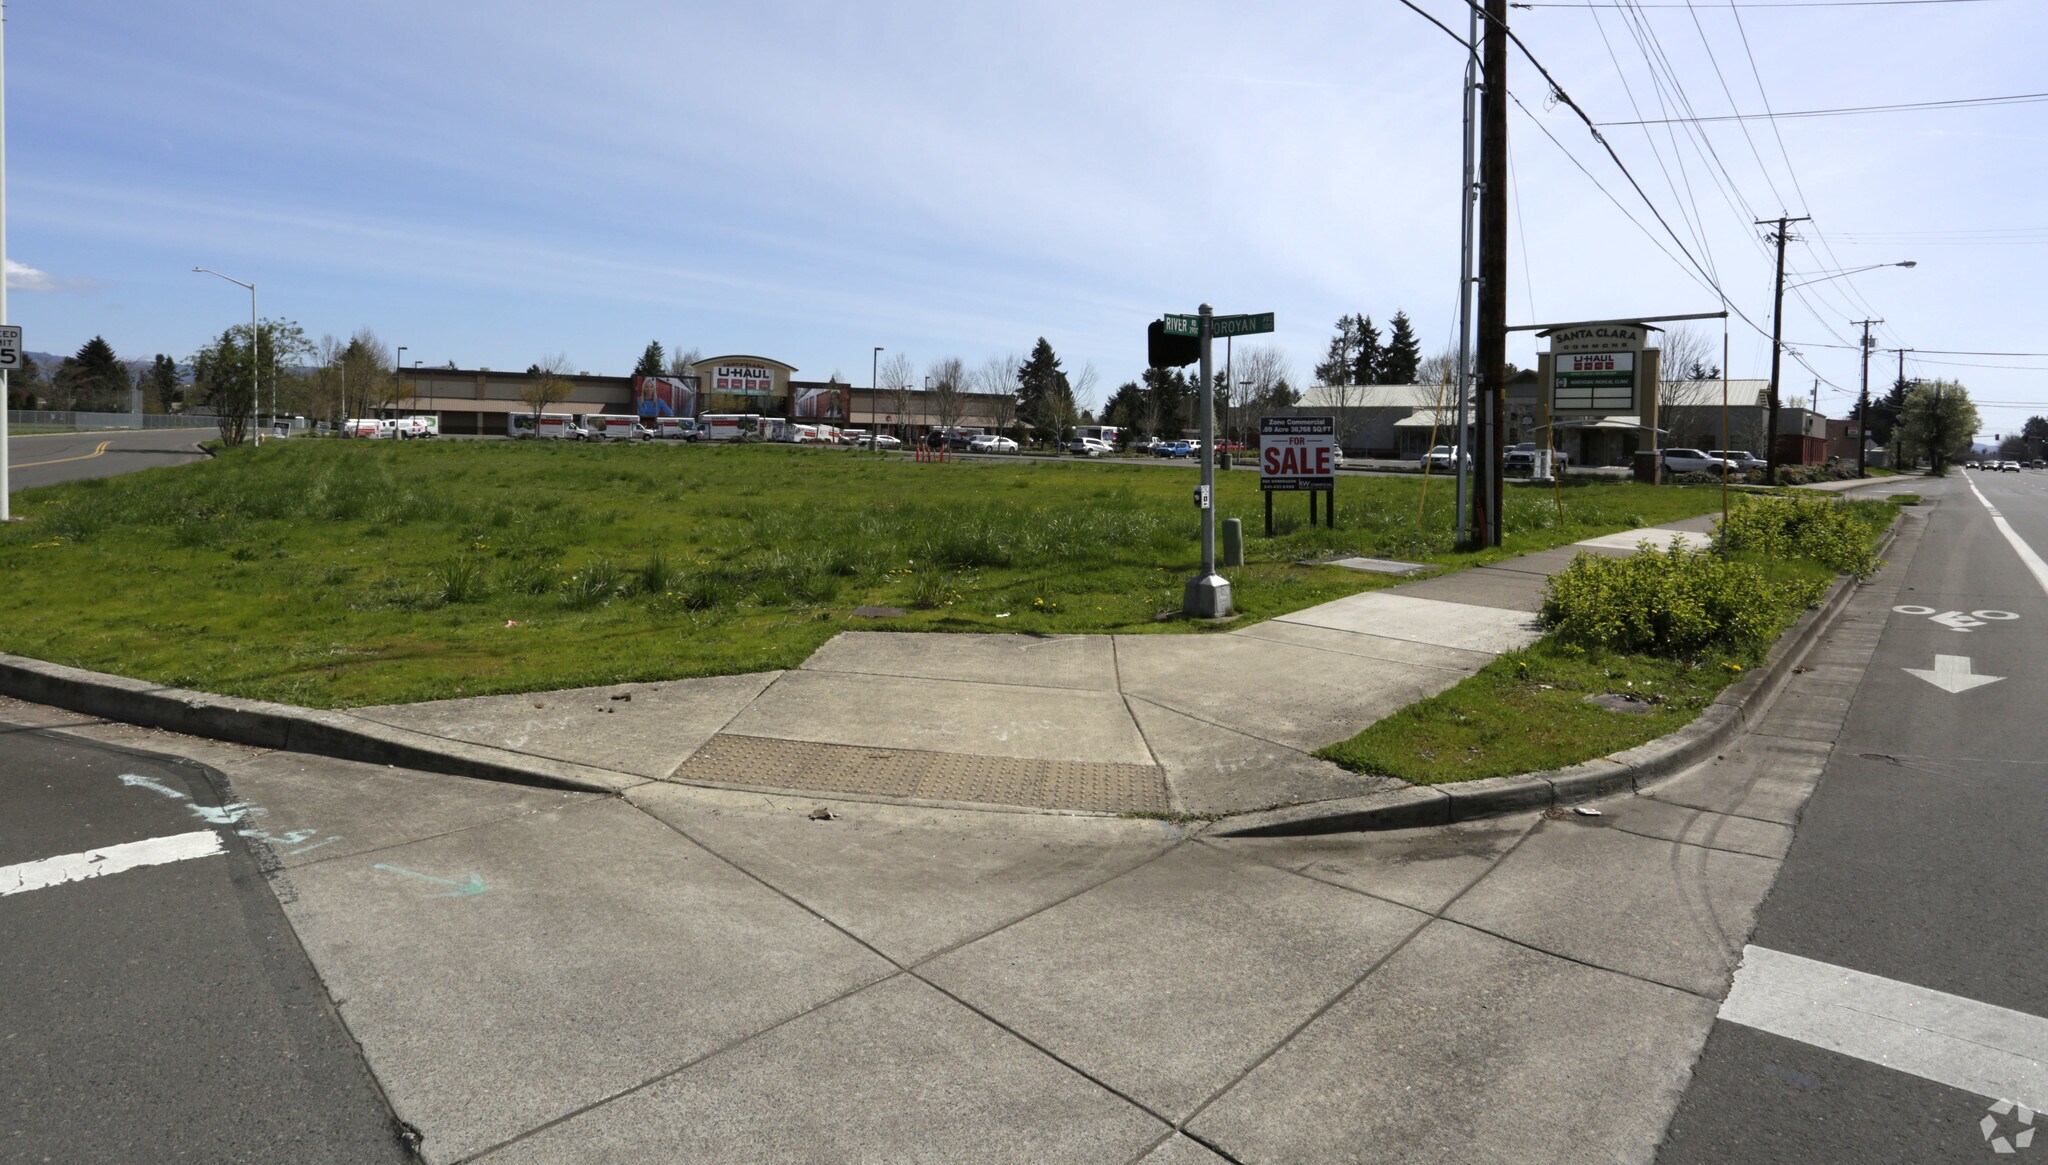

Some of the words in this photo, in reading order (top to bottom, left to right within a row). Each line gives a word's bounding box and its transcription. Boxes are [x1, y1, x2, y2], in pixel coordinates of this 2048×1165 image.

[1166, 317, 1187, 332] RIVER
[1214, 318, 1257, 335] OROYAN
[0, 330, 18, 338] ED
[1556, 329, 1593, 343] SANTA
[1596, 328, 1636, 341] CLARA
[1563, 342, 1627, 350] COMMONS
[718, 367, 769, 378] U-HAUL
[1289, 437, 1305, 445] FOR
[1264, 447, 1331, 475] SALE
